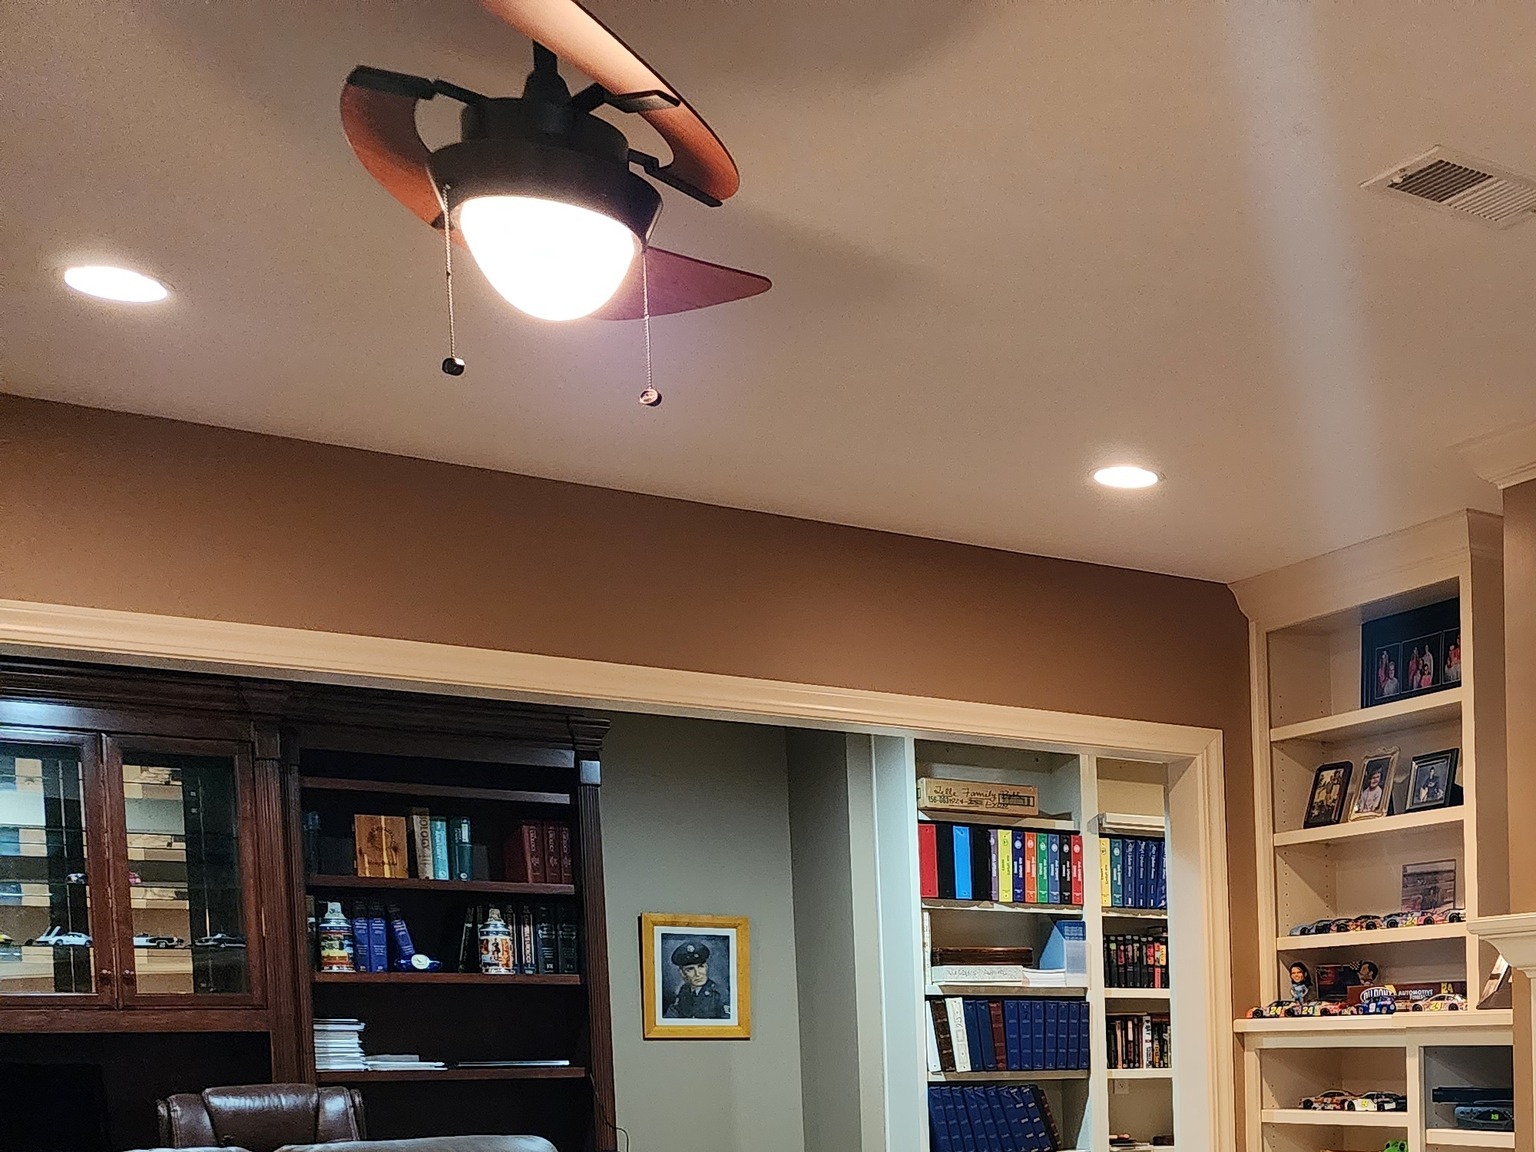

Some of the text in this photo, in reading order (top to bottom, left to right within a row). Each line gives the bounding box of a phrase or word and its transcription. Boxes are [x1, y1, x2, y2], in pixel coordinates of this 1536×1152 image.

[1440, 983, 1454, 994] 24
[1270, 1006, 1281, 1015] 24
[1302, 1006, 1314, 1015] 24
